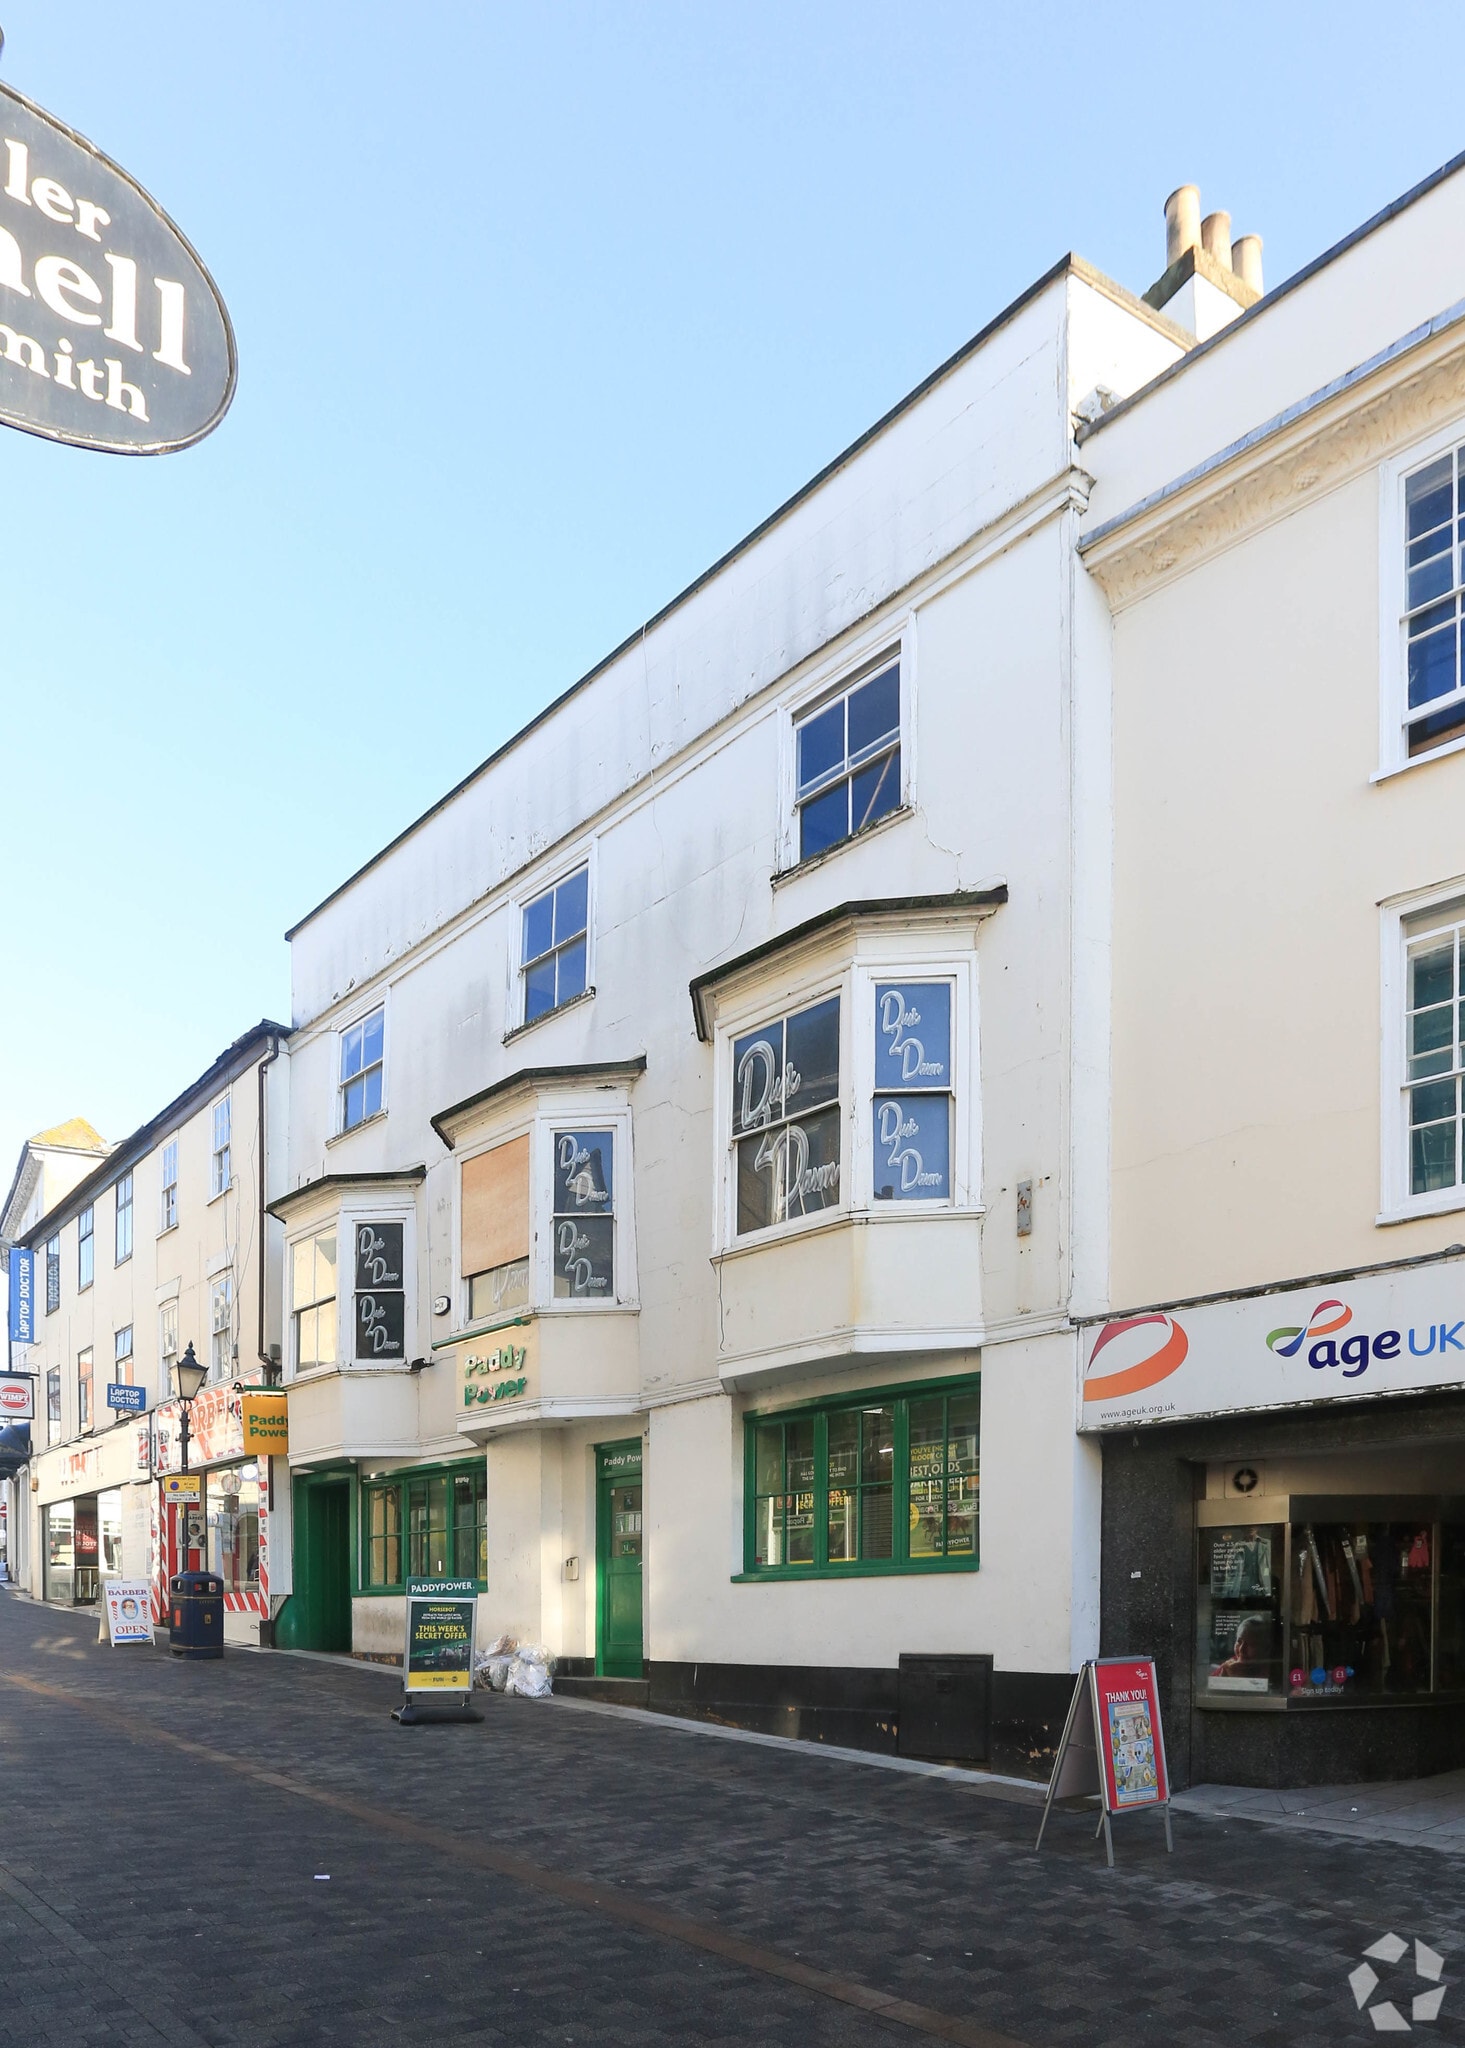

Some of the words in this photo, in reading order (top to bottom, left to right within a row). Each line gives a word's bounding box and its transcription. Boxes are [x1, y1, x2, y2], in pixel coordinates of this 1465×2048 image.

[4, 138, 111, 243] ler
[19, 1257, 30, 1299] DOCTOR
[19, 1301, 30, 1339] LAPTOP
[1307, 1330, 1401, 1378] age
[1408, 1320, 1465, 1357] UK
[465, 1344, 526, 1378] Paddy
[110, 1388, 140, 1398] LAPTOP
[464, 1376, 528, 1406] Power
[110, 1395, 140, 1406] DOCTOR
[1099, 1402, 1176, 1420] www.ageuk.org.uk
[603, 1456, 626, 1467] Paddy
[115, 1625, 149, 1635] OPEN
[415, 1632, 442, 1640] SECRET
[1292, 1673, 1302, 1682] £1
[1336, 1670, 1345, 1679] £1
[1105, 1691, 1130, 1703] THANK
[1130, 1689, 1148, 1700] YOU!
[1301, 1687, 1315, 1696] Sign
[1315, 1687, 1324, 1695] up
